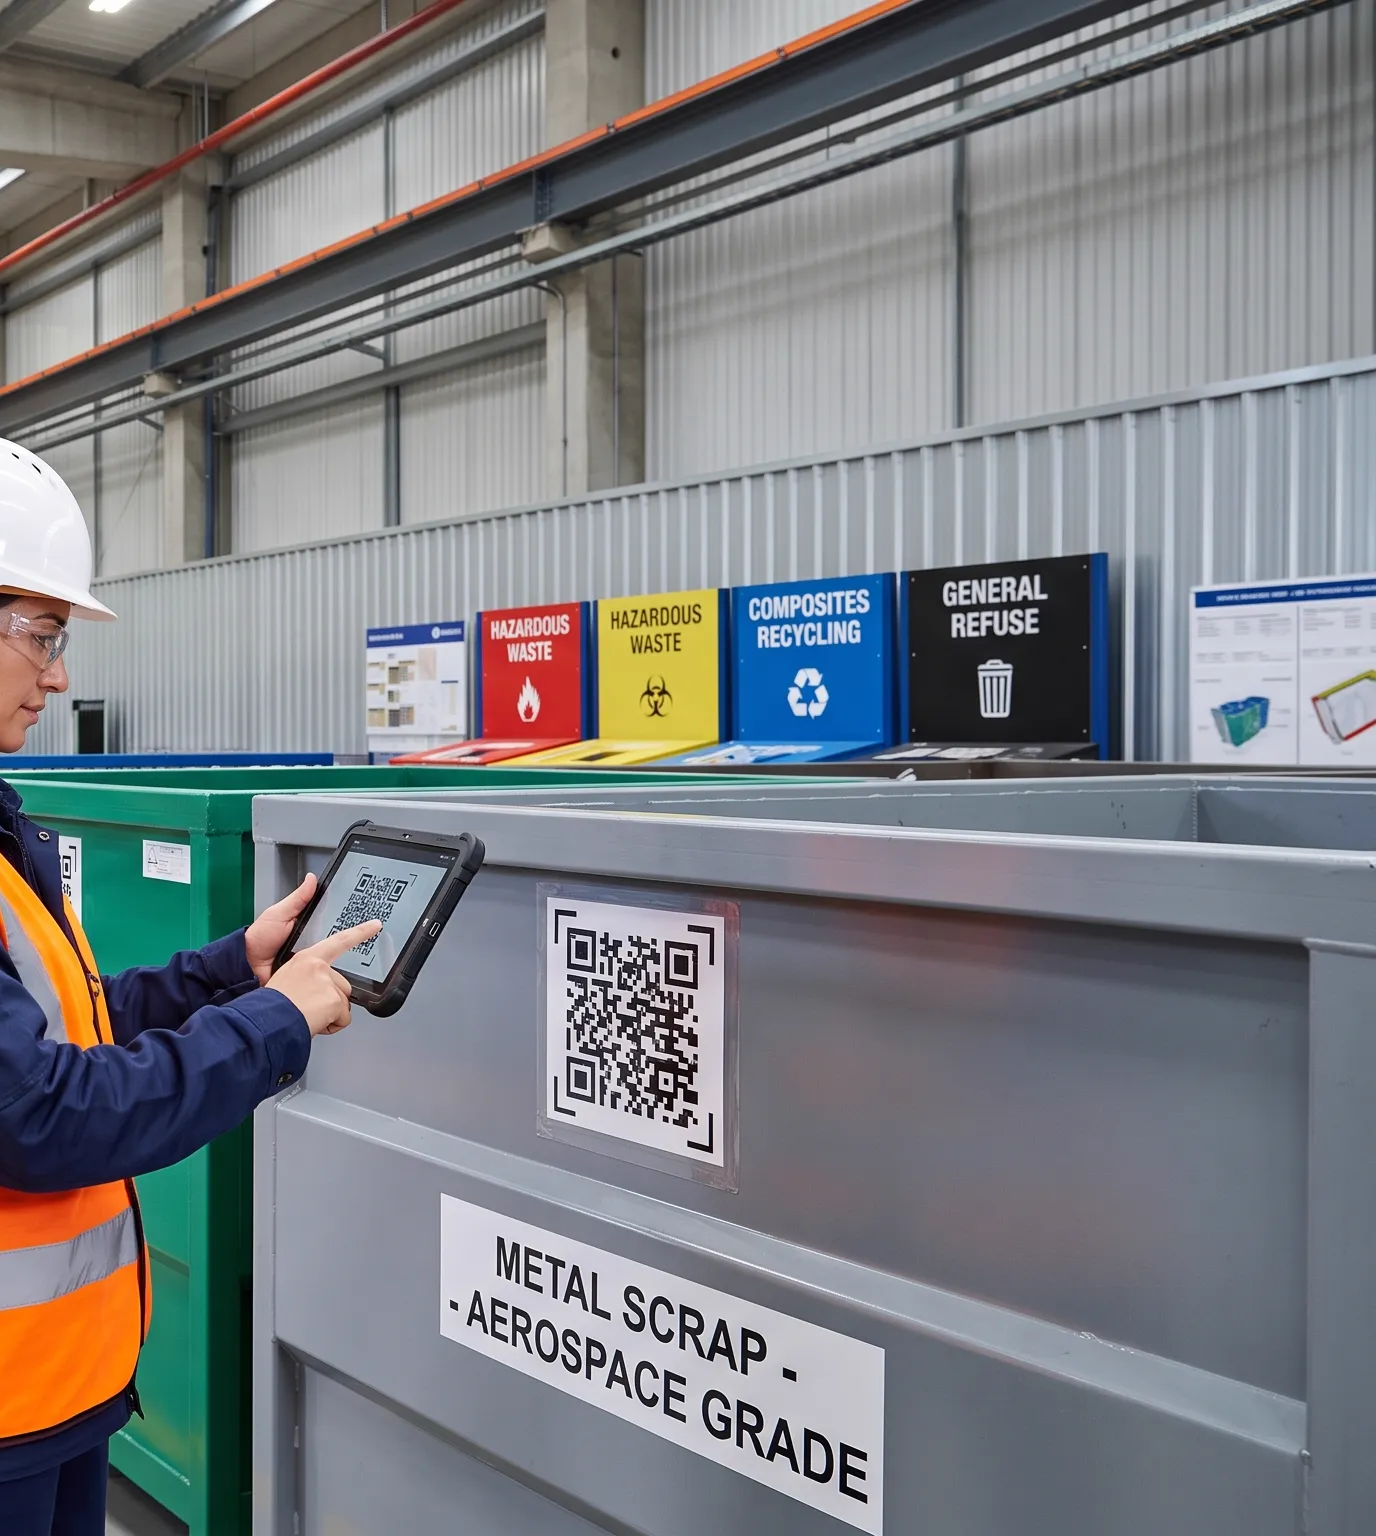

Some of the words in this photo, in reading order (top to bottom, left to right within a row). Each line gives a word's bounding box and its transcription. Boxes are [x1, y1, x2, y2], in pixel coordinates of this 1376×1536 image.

[748, 588, 870, 621] COMPOSITES
[942, 574, 1049, 607] GENERAL
[490, 613, 570, 640] HAZARDOUS
[611, 603, 702, 630] HAZARDOUS
[950, 608, 1040, 639] REFUSE
[630, 632, 682, 655] WASTE
[757, 619, 861, 649] RECYCLING
[507, 640, 553, 663] WASTE
[496, 1235, 612, 1321] METAL
[622, 1285, 767, 1376] SCRAP
[466, 1289, 687, 1424] AEROSPACE
[701, 1389, 868, 1505] GRADE
